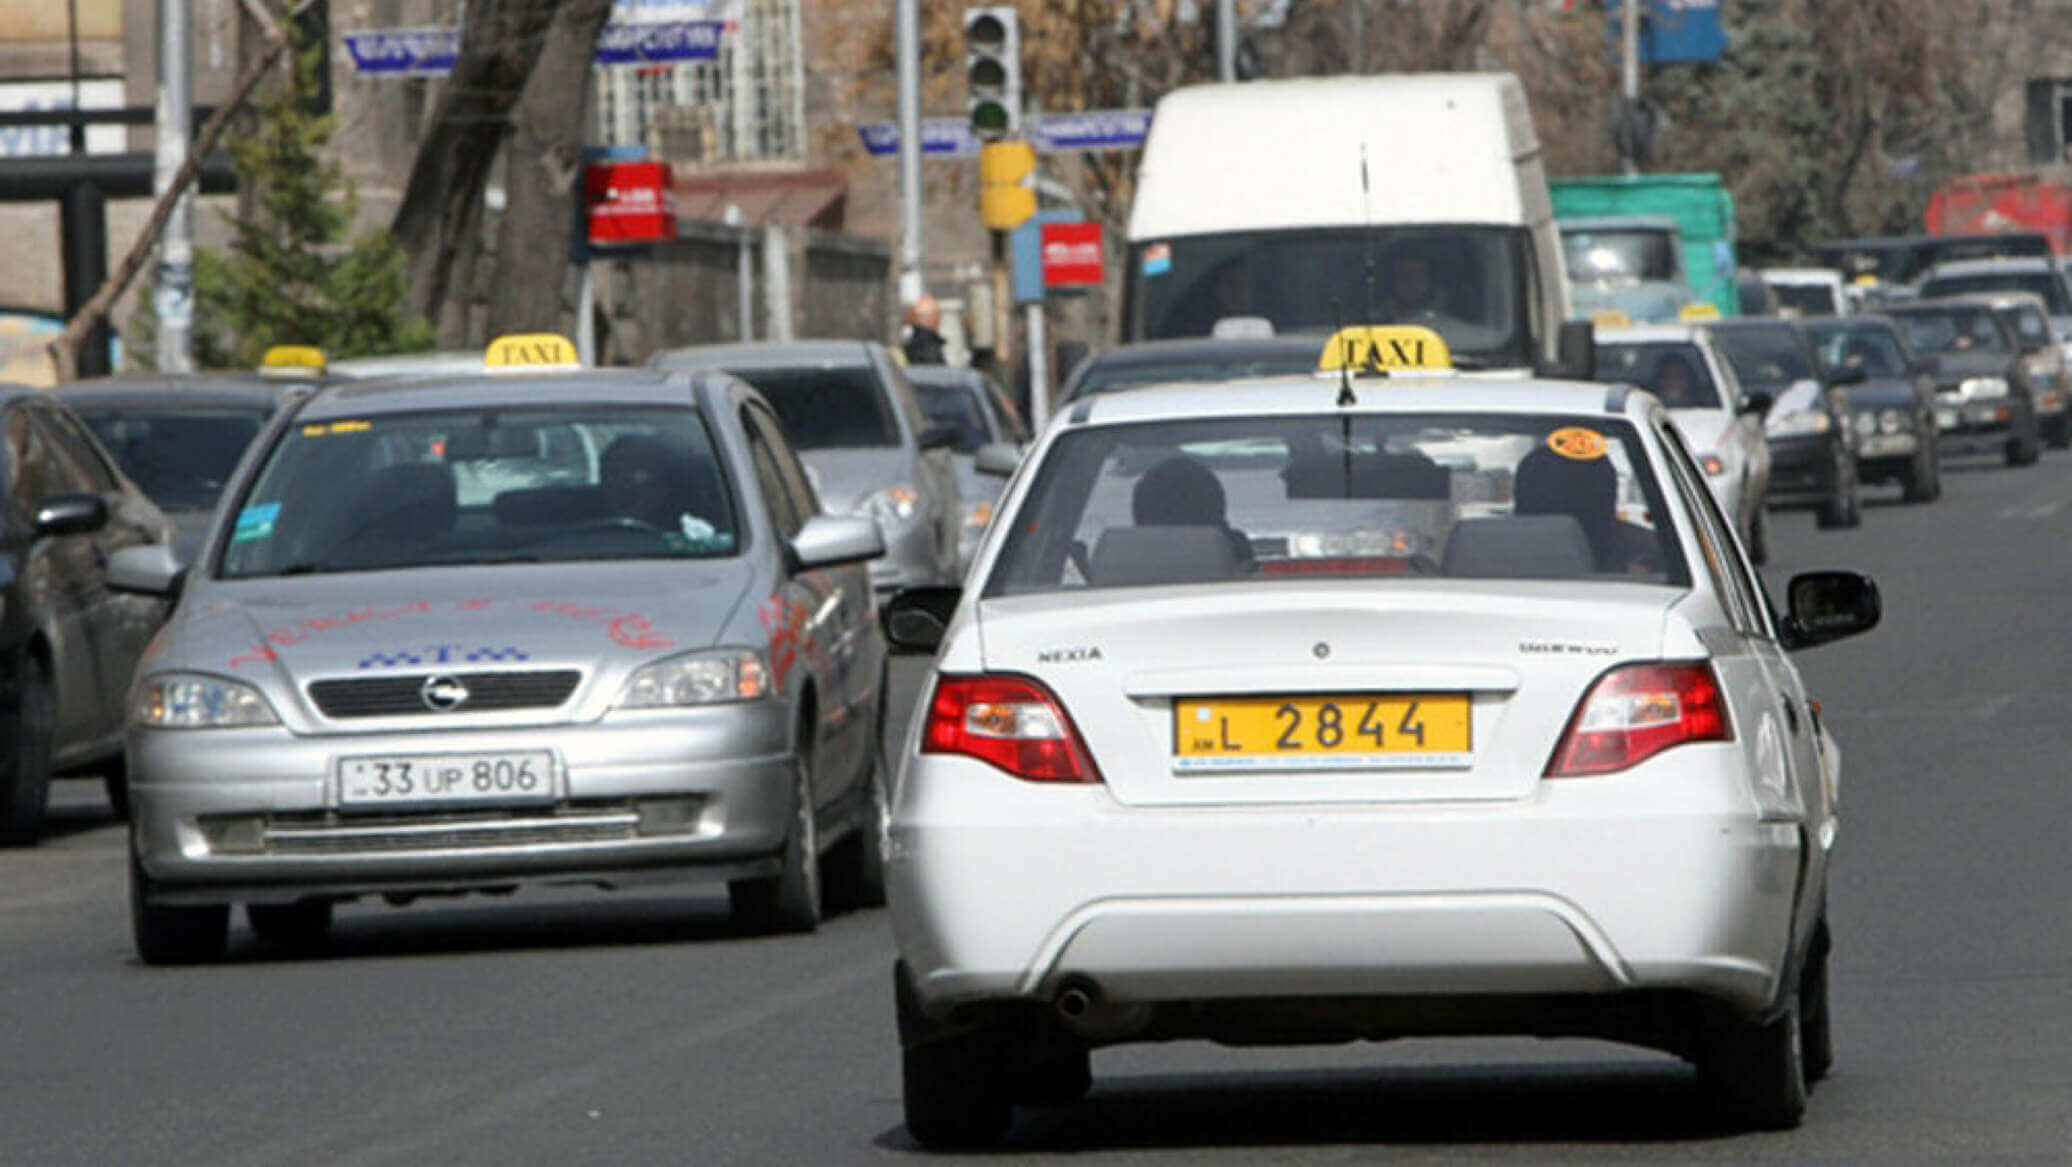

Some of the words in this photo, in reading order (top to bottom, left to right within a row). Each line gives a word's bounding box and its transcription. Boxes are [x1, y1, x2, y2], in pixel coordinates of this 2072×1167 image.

[498, 344, 563, 364] TAXI
[1342, 339, 1424, 366] TAXI
[1037, 645, 1103, 662] NEXIA
[1220, 716, 1242, 751] L
[1274, 701, 1425, 750] 2844
[372, 762, 414, 796] 33
[423, 767, 463, 794] UP
[471, 759, 538, 792] 806
